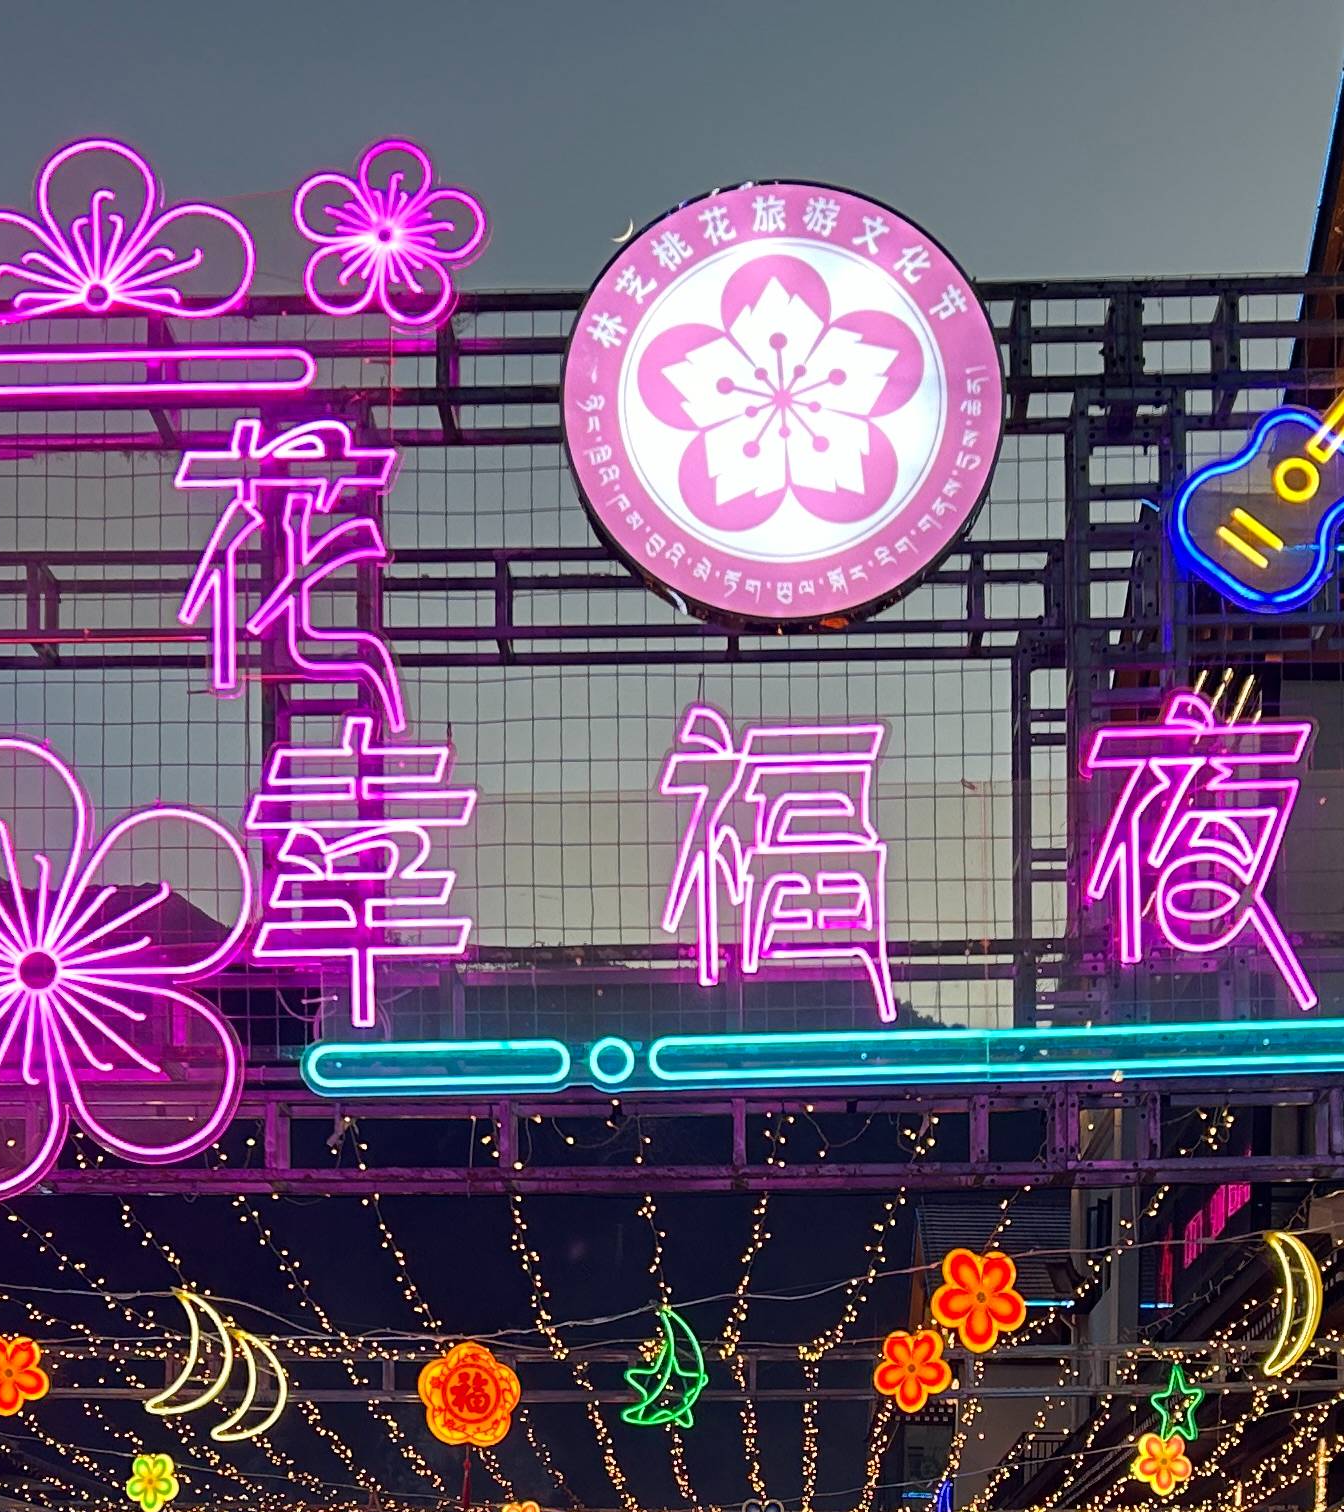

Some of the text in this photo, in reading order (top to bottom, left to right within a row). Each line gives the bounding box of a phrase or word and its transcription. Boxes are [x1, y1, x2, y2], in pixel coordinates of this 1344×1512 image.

[587, 194, 968, 349] 林芝桃花旅游文化节
